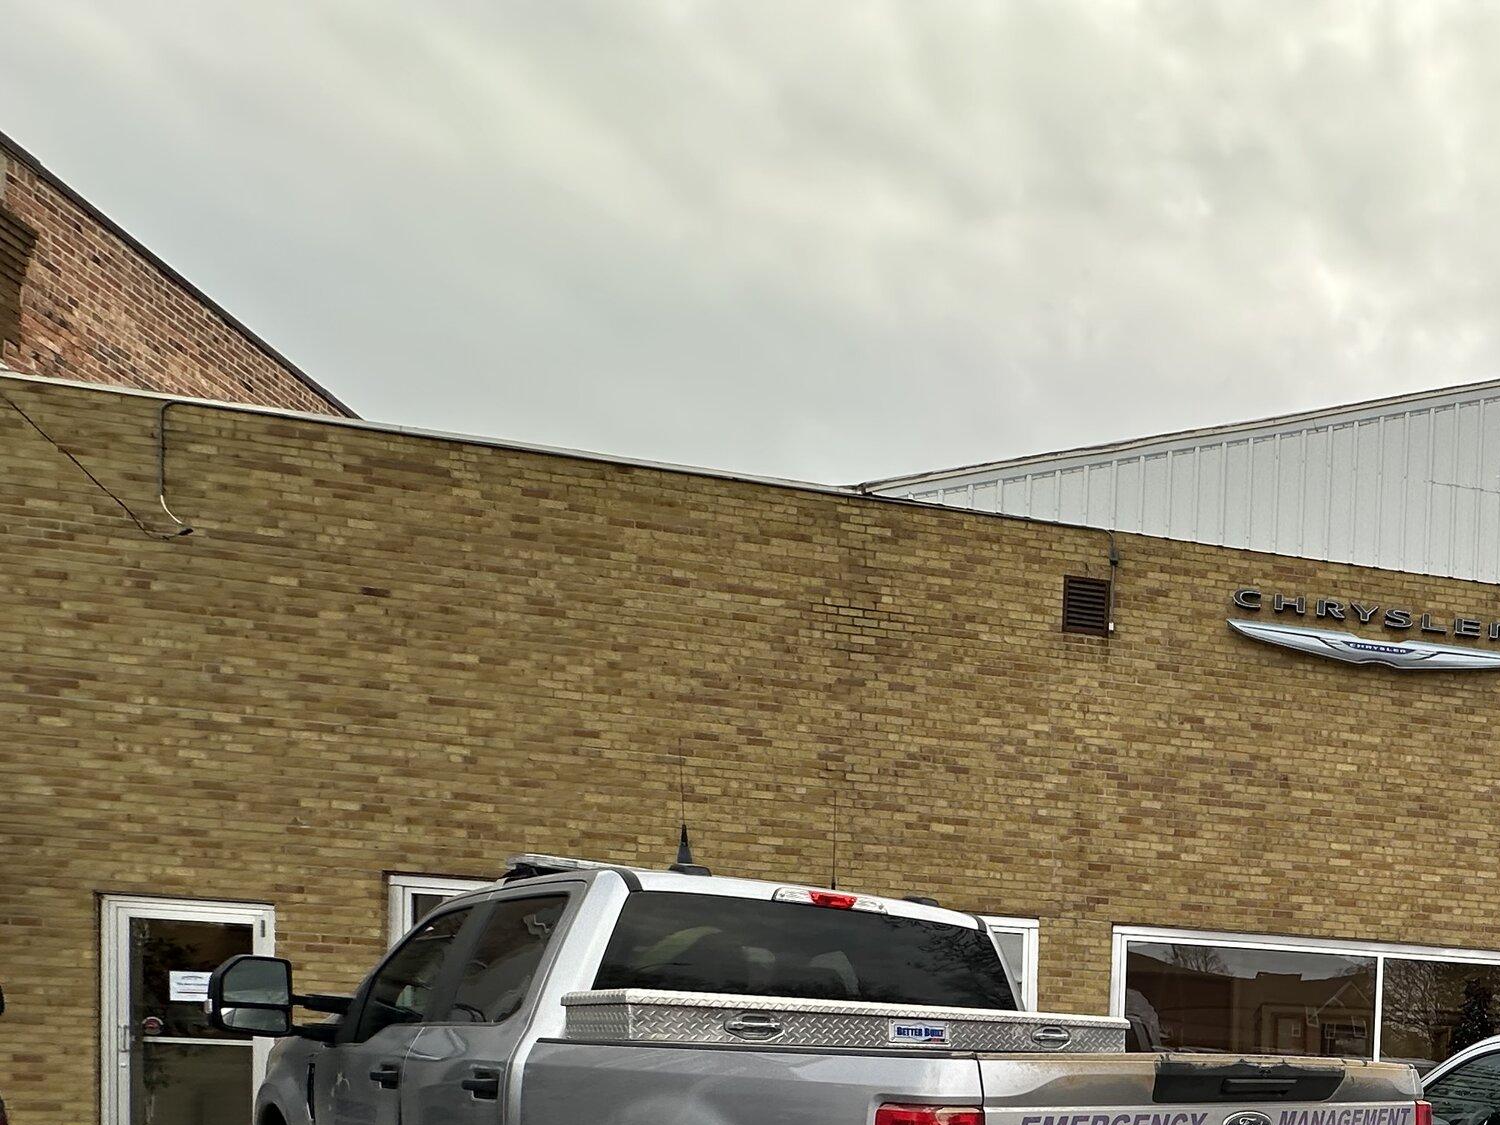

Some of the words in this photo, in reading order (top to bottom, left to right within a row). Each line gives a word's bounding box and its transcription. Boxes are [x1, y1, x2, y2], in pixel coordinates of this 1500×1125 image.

[1349, 642, 1407, 655] CHRYSLER
[896, 1026, 923, 1037] BETTER
[924, 1027, 944, 1038] BUILT
